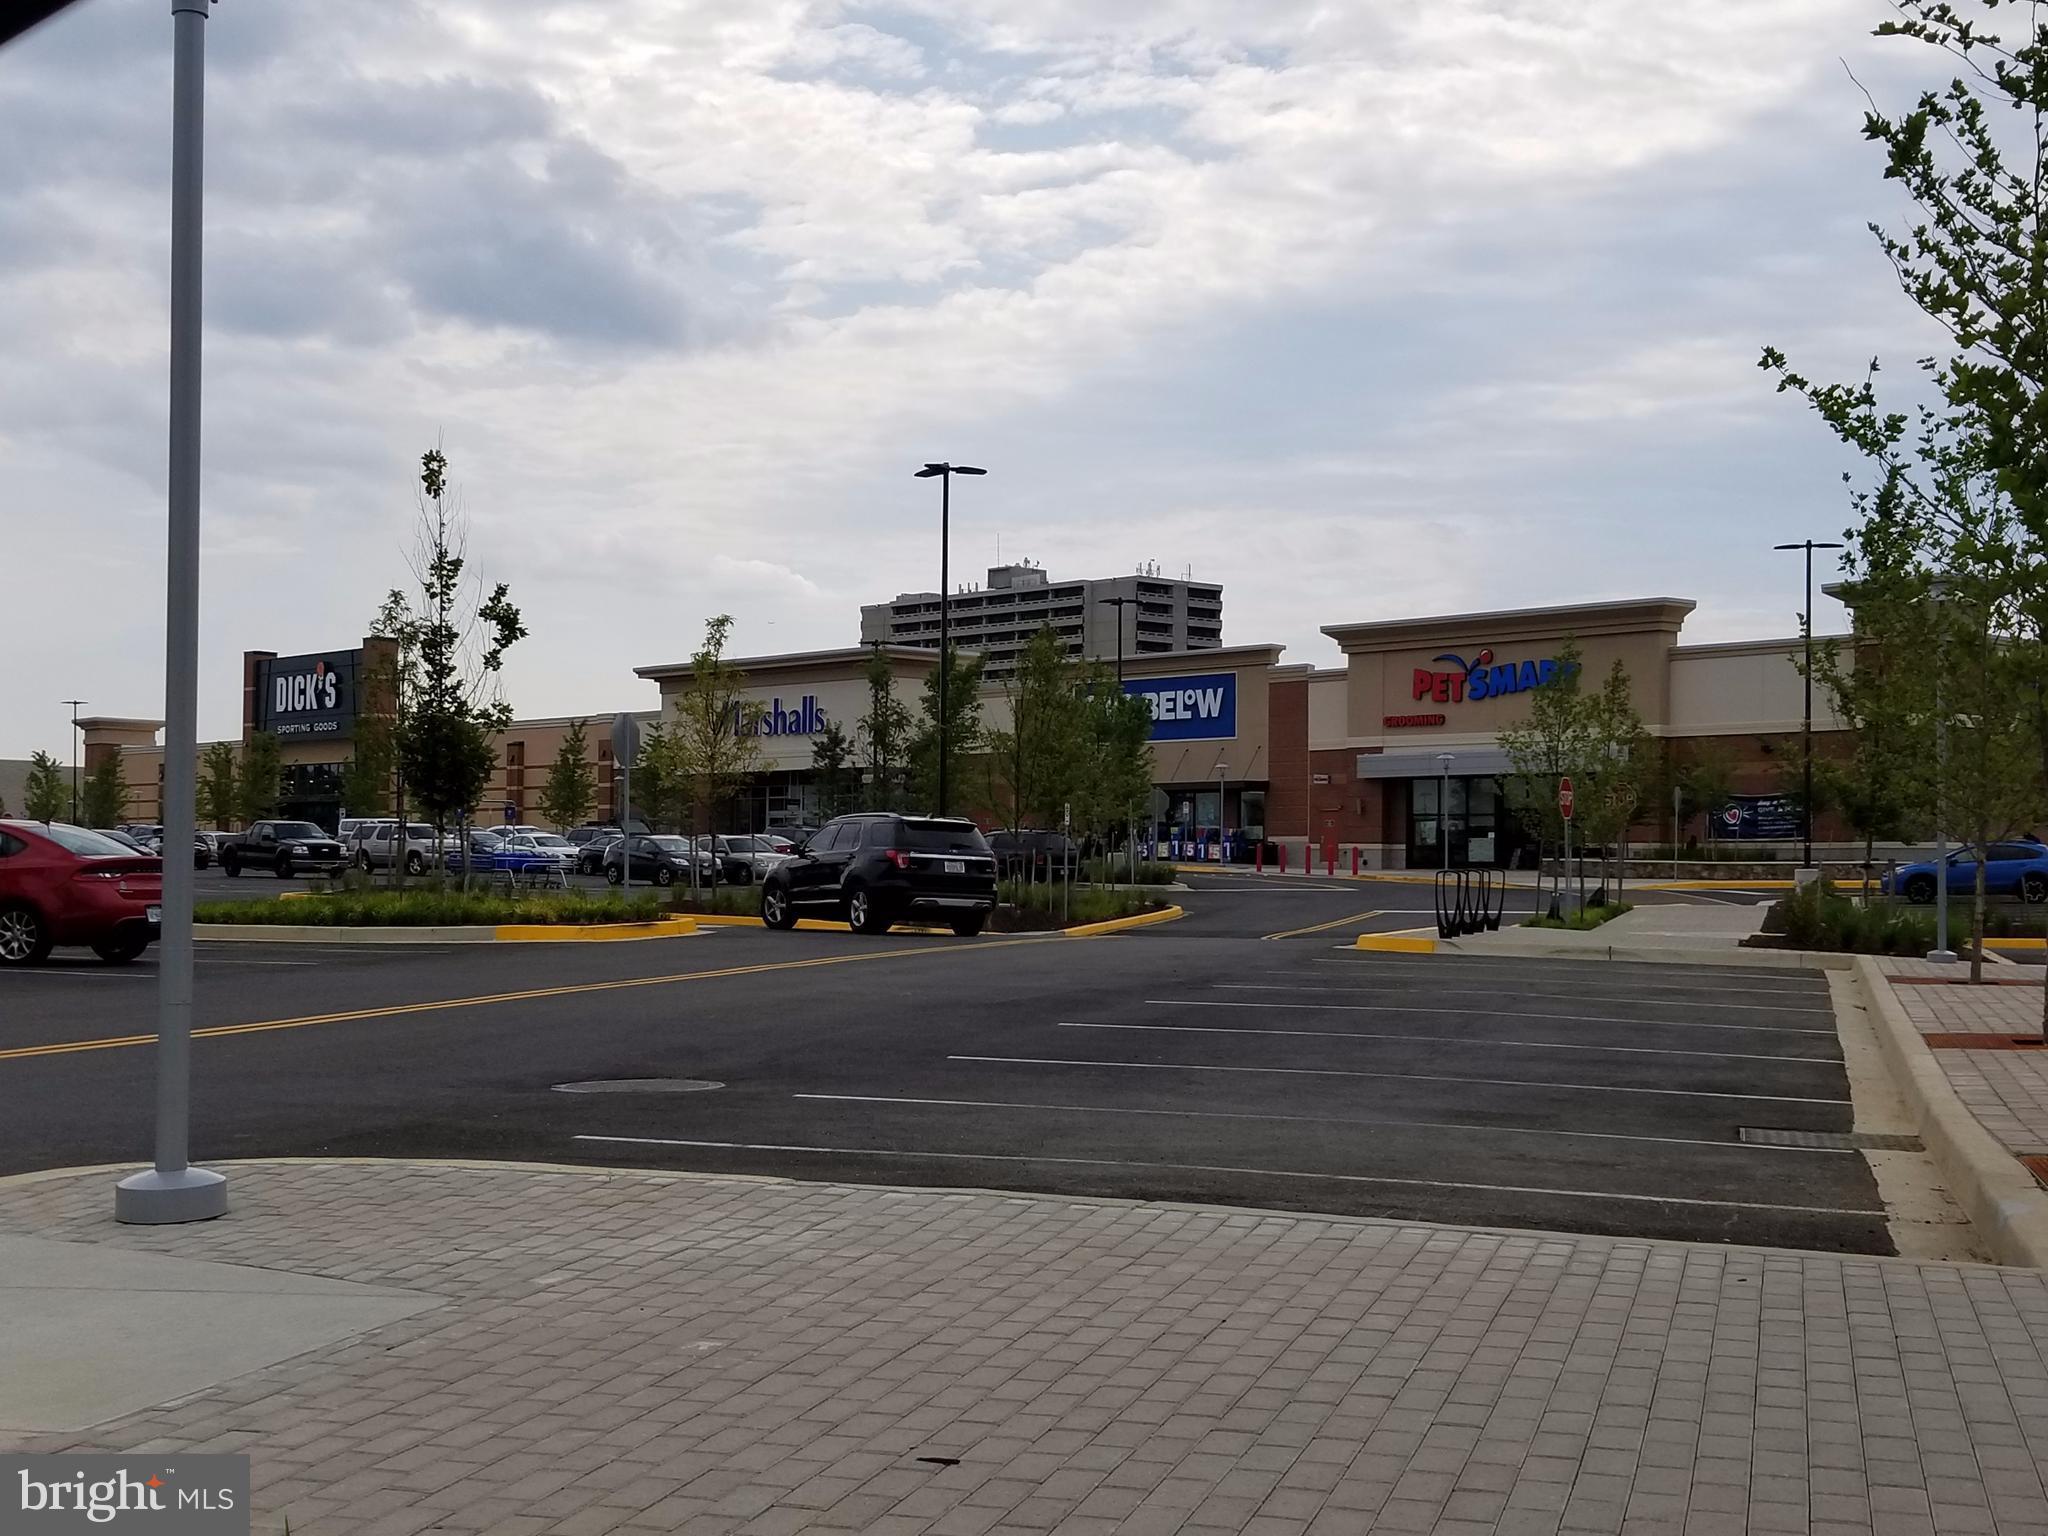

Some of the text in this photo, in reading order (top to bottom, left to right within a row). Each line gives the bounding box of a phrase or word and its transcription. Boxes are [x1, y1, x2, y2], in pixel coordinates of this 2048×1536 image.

[275, 671, 337, 712] DICK'S
[1383, 714, 1445, 727] GROOMING
[277, 721, 338, 734] SPORTING GOODS
